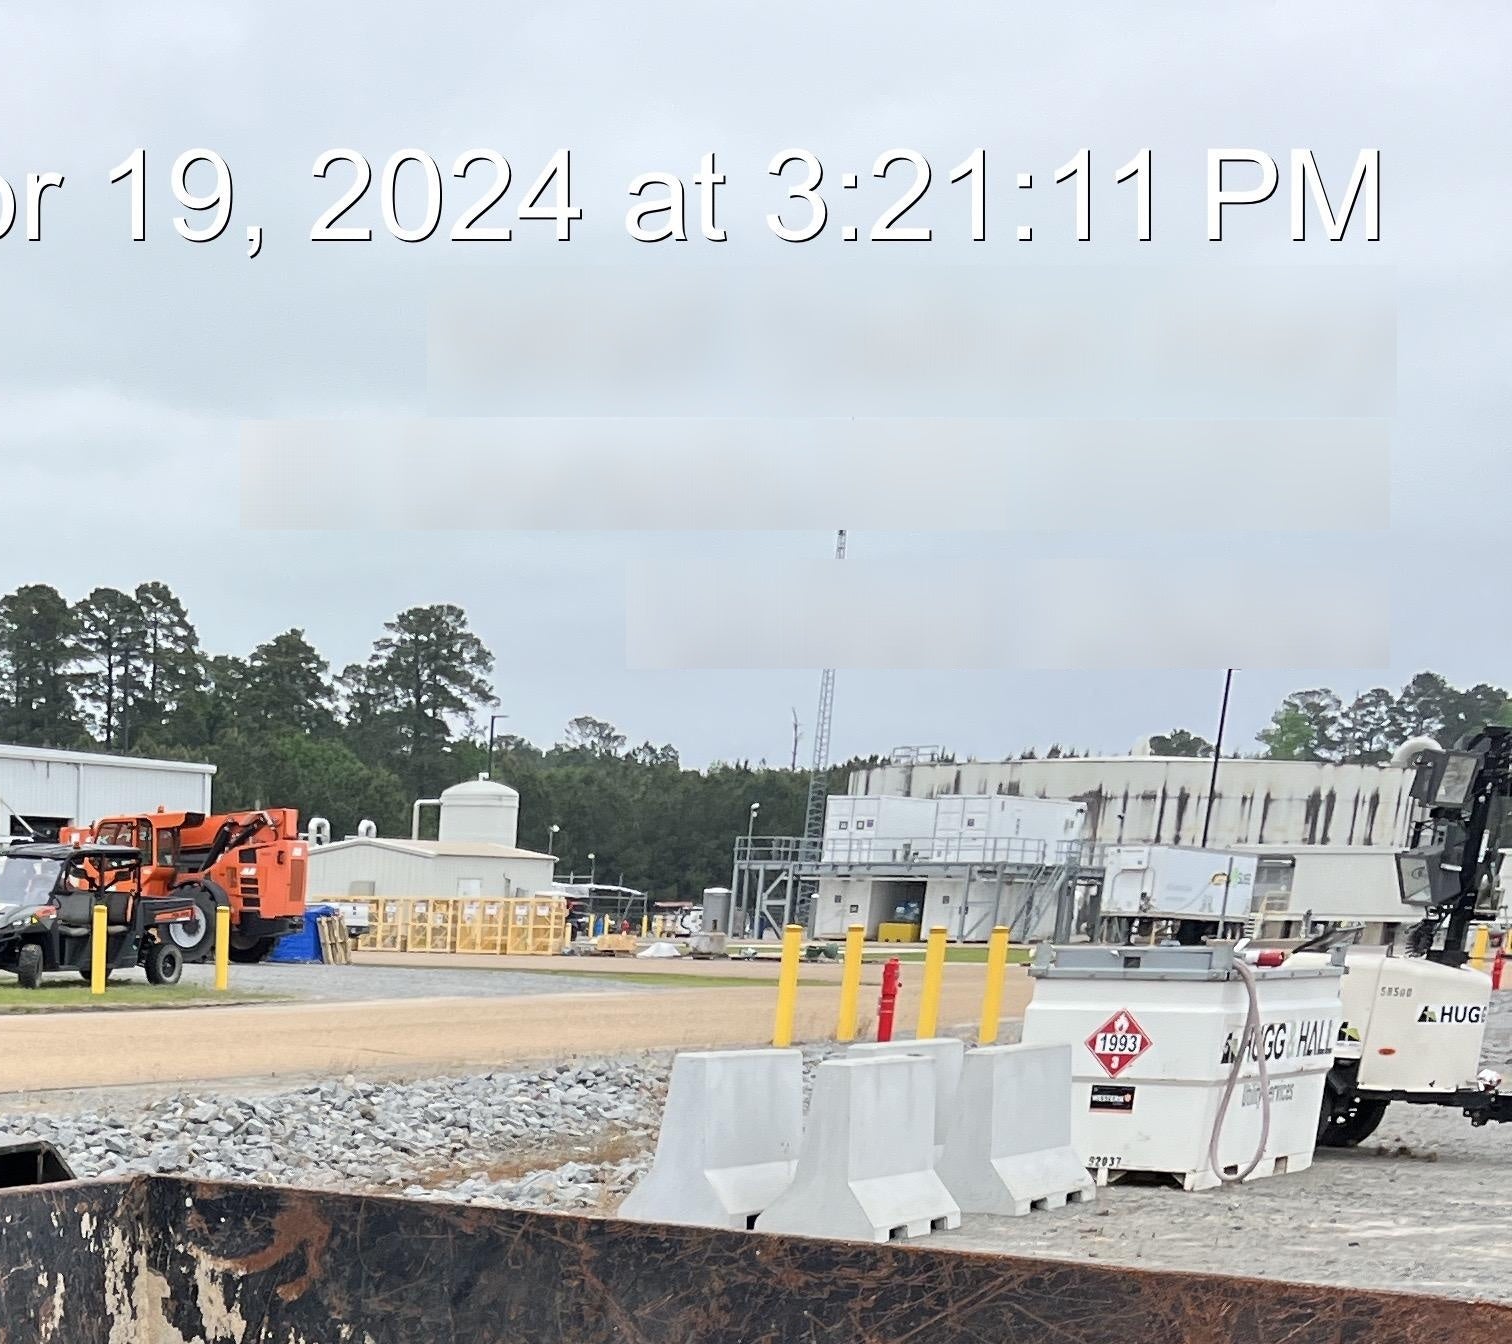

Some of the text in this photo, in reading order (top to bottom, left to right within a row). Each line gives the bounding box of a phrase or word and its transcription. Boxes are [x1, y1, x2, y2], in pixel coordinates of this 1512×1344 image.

[1099, 1034, 1138, 1052] 1993
[1296, 1019, 1334, 1057] HALL
[1110, 1055, 1120, 1069] 3
